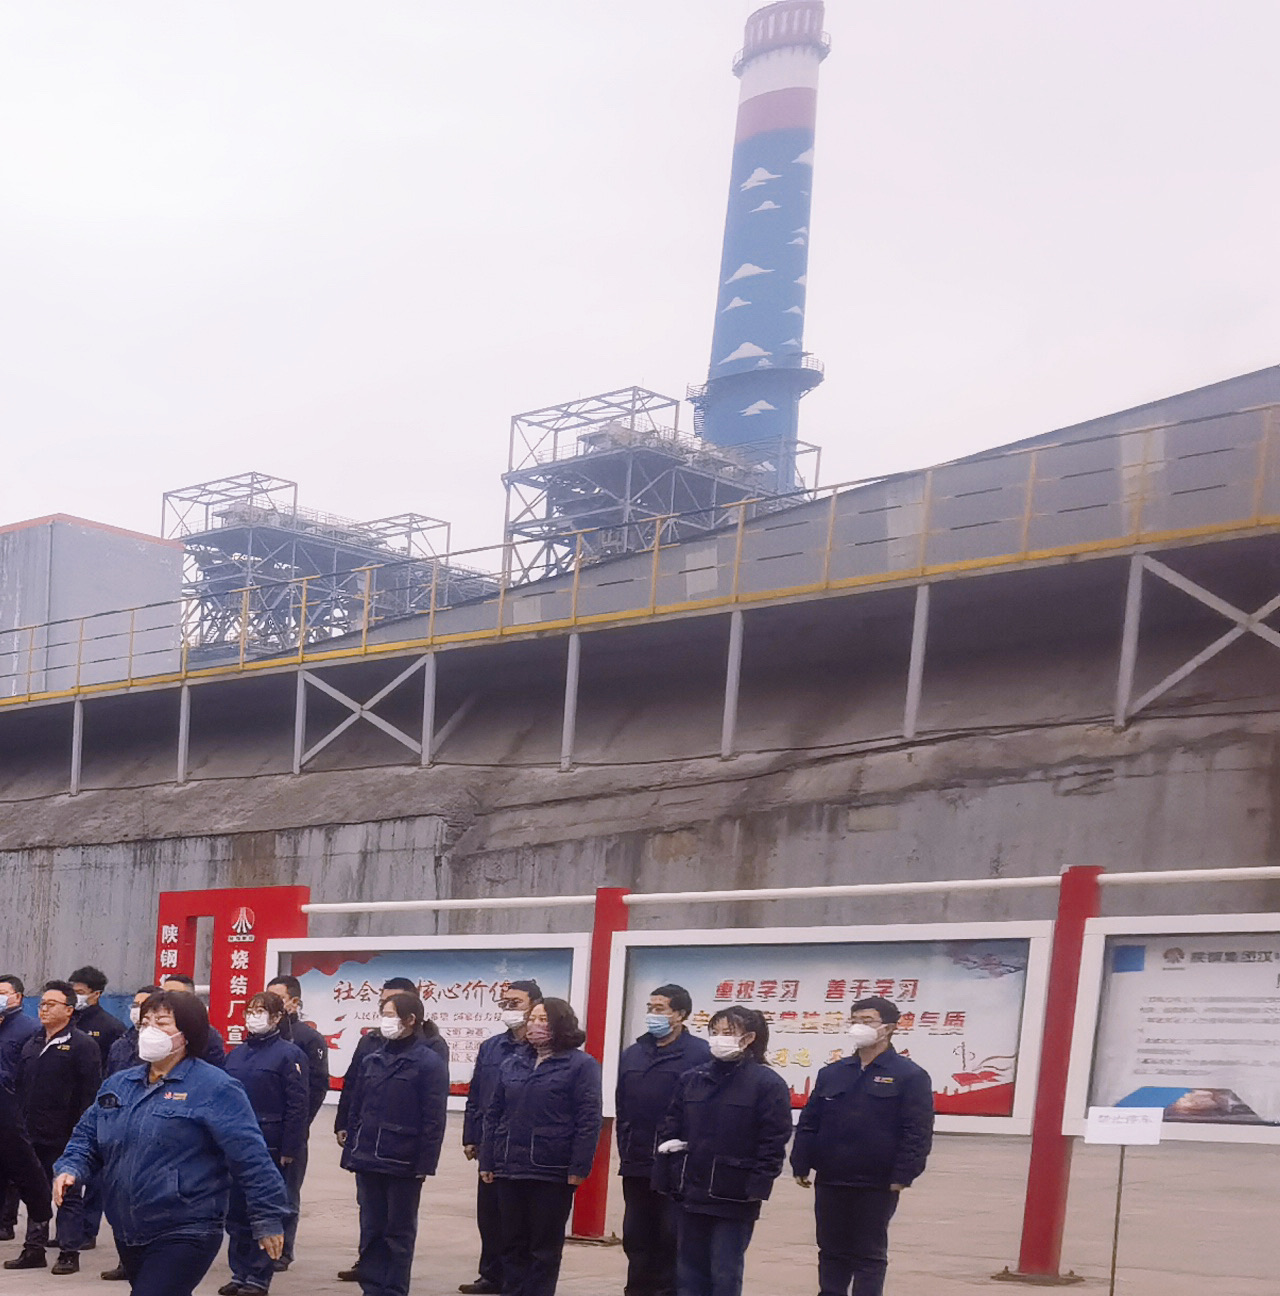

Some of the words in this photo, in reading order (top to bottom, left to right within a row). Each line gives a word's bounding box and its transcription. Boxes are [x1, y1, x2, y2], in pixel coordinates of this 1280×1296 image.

[713, 979, 800, 1002] 重视学习
[825, 979, 919, 1002] 善于学习
